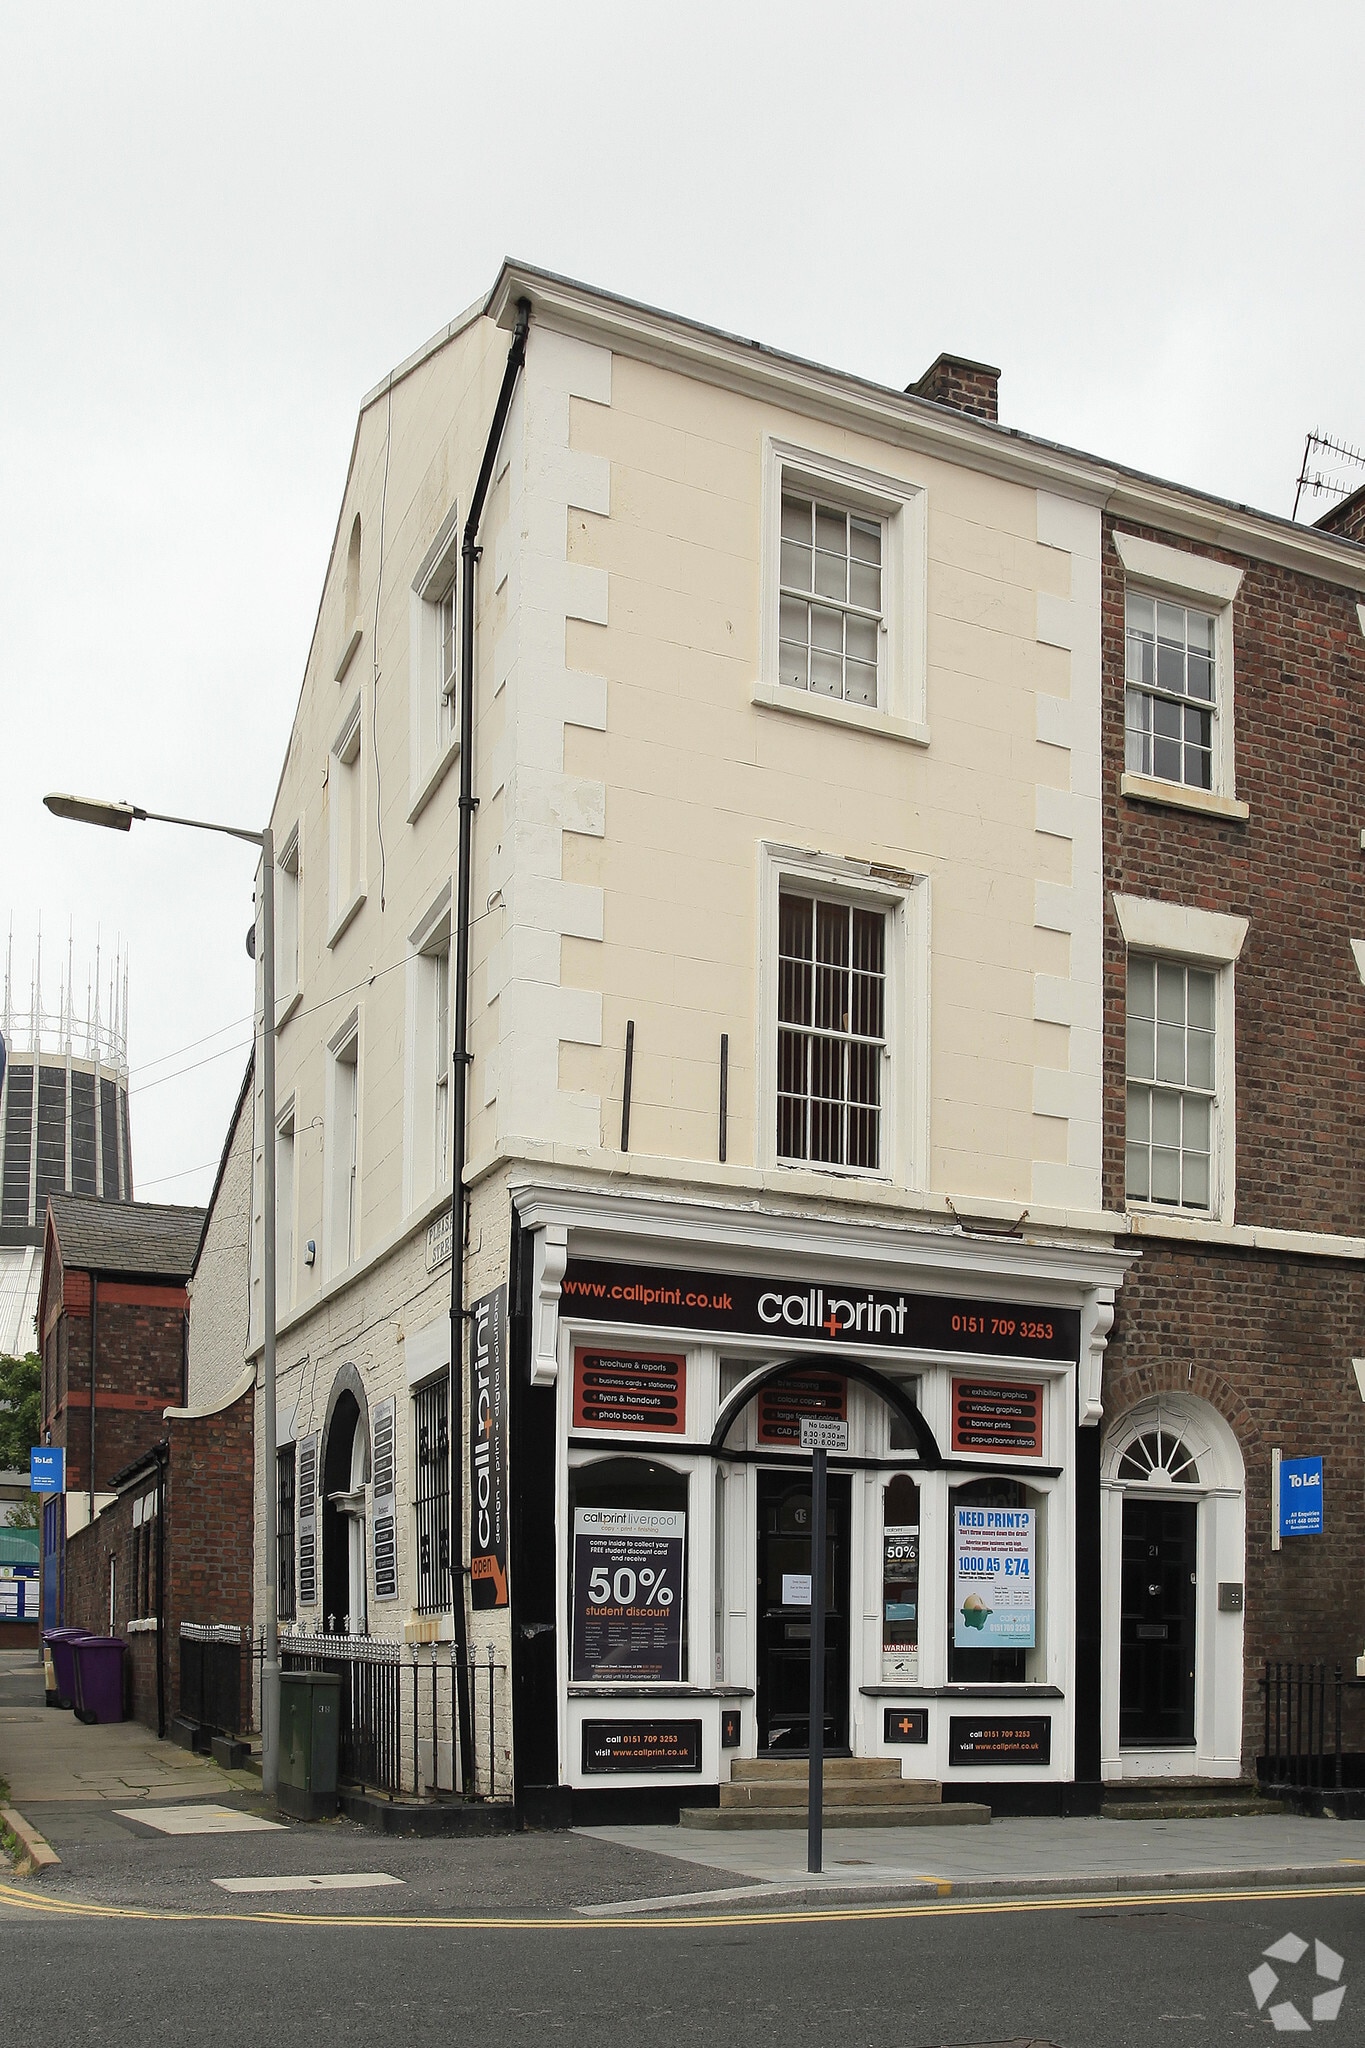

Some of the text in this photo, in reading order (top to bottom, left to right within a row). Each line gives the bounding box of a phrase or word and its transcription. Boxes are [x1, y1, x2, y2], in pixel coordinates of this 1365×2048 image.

[432, 1235, 453, 1262] STRE
[563, 1280, 733, 1310] www.callprint.co.uk
[951, 1314, 1054, 1339] 0151 709 3253
[600, 1359, 666, 1372] brochure & reports
[599, 1377, 624, 1386] business
[625, 1379, 642, 1387] cards
[648, 1381, 676, 1390] stationery
[599, 1393, 660, 1405] flyers & handouts
[971, 1389, 1028, 1399] exhibition graphics
[777, 1396, 799, 1404] colour
[971, 1404, 1022, 1414] window graphics
[598, 1410, 645, 1421] photo books
[777, 1411, 795, 1420] large
[818, 1422, 841, 1431] loading
[994, 1421, 1011, 1429] prints
[776, 1427, 792, 1435] CAD
[33, 1456, 42, 1464] To
[1288, 1472, 1320, 1488] To Let
[583, 1511, 677, 1526] callprint liverpool
[958, 1511, 1030, 1528] NEED PRINT?
[887, 1545, 916, 1559] 50%
[1149, 1545, 1159, 1556] 21
[473, 1558, 492, 1578] open
[958, 1556, 1030, 1576] 1000 A5 £74
[587, 1567, 674, 1606] 50%
[586, 1606, 670, 1617] student discount
[989, 1623, 1003, 1632] 0151
[606, 1735, 678, 1743] call 0151 709 3253
[969, 1730, 1031, 1738] call 0151 709 3253
[960, 1742, 1039, 1751] visit www.callprint.co.uk
[595, 1748, 689, 1758] visit www.callprint.co.uk
